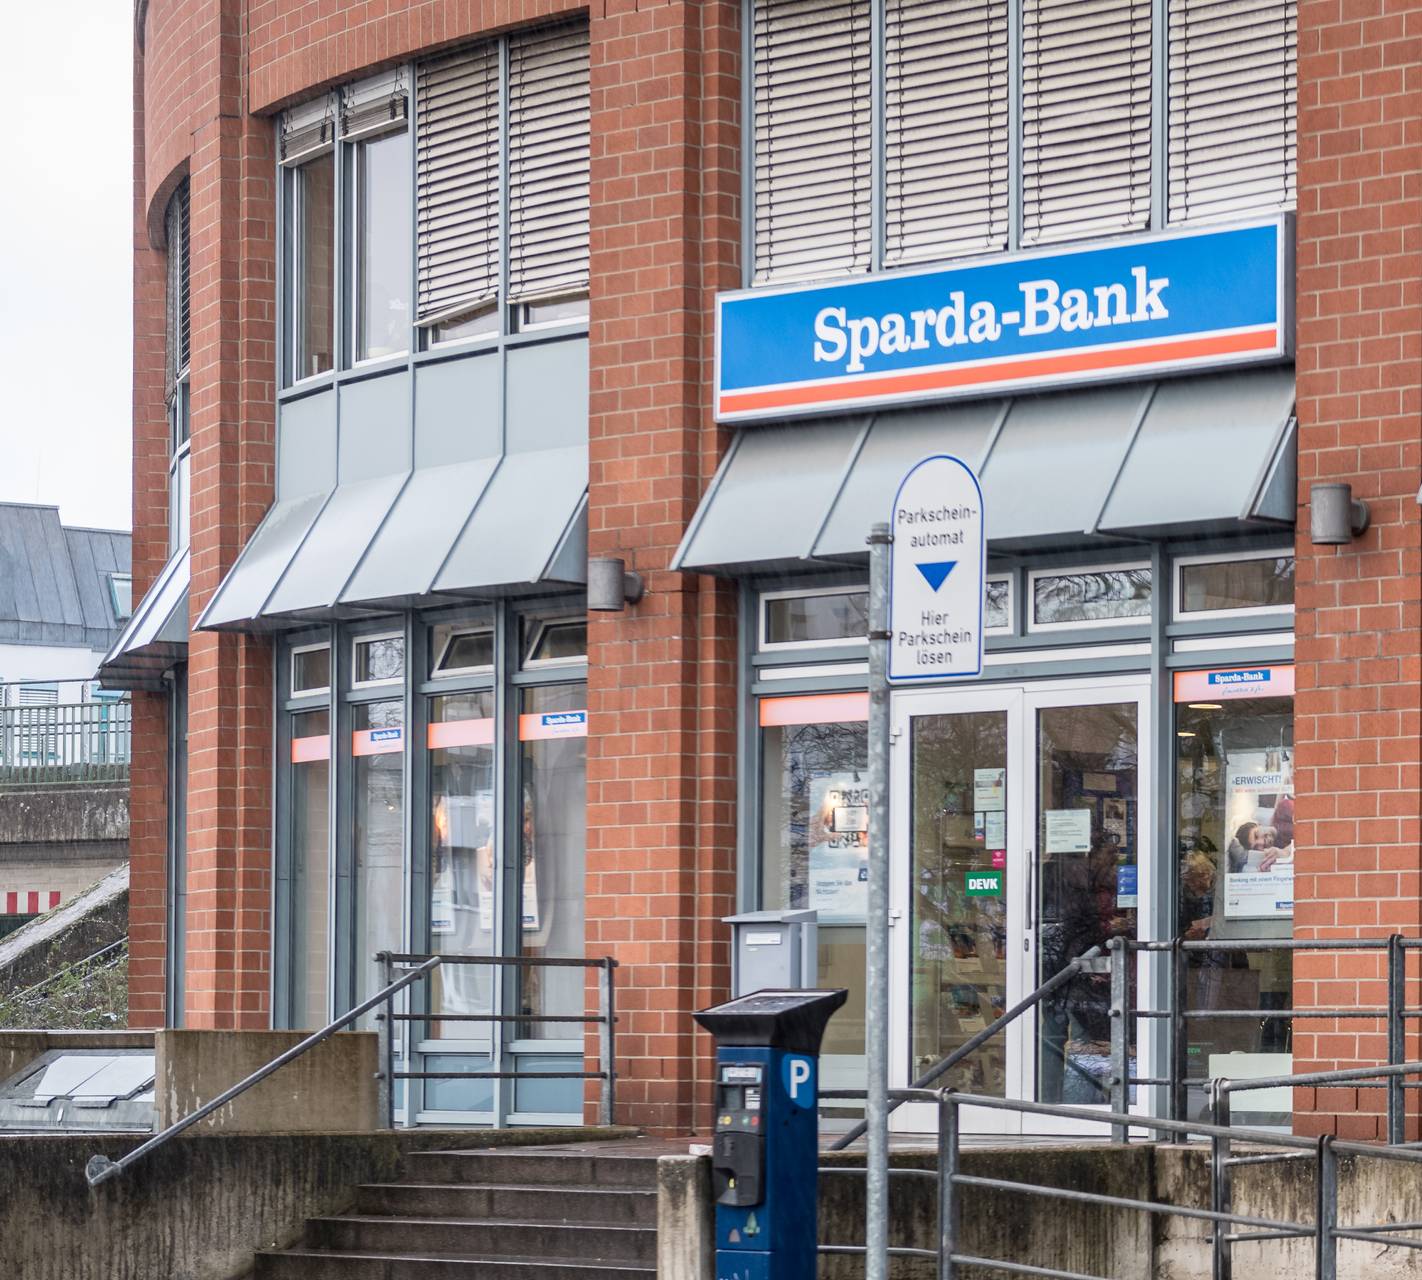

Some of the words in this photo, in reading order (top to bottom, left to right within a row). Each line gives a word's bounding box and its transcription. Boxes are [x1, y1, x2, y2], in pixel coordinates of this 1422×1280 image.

[814, 266, 1169, 372] Sparda-Bank
[898, 505, 976, 525] Parkschein-
[911, 530, 964, 547] automat
[920, 610, 949, 627] Hier
[899, 628, 972, 648] Parkschein
[916, 648, 953, 666] lösen
[1214, 671, 1264, 685] Sparda-Bank
[968, 878, 999, 890] DEVK
[790, 1060, 810, 1099] P
